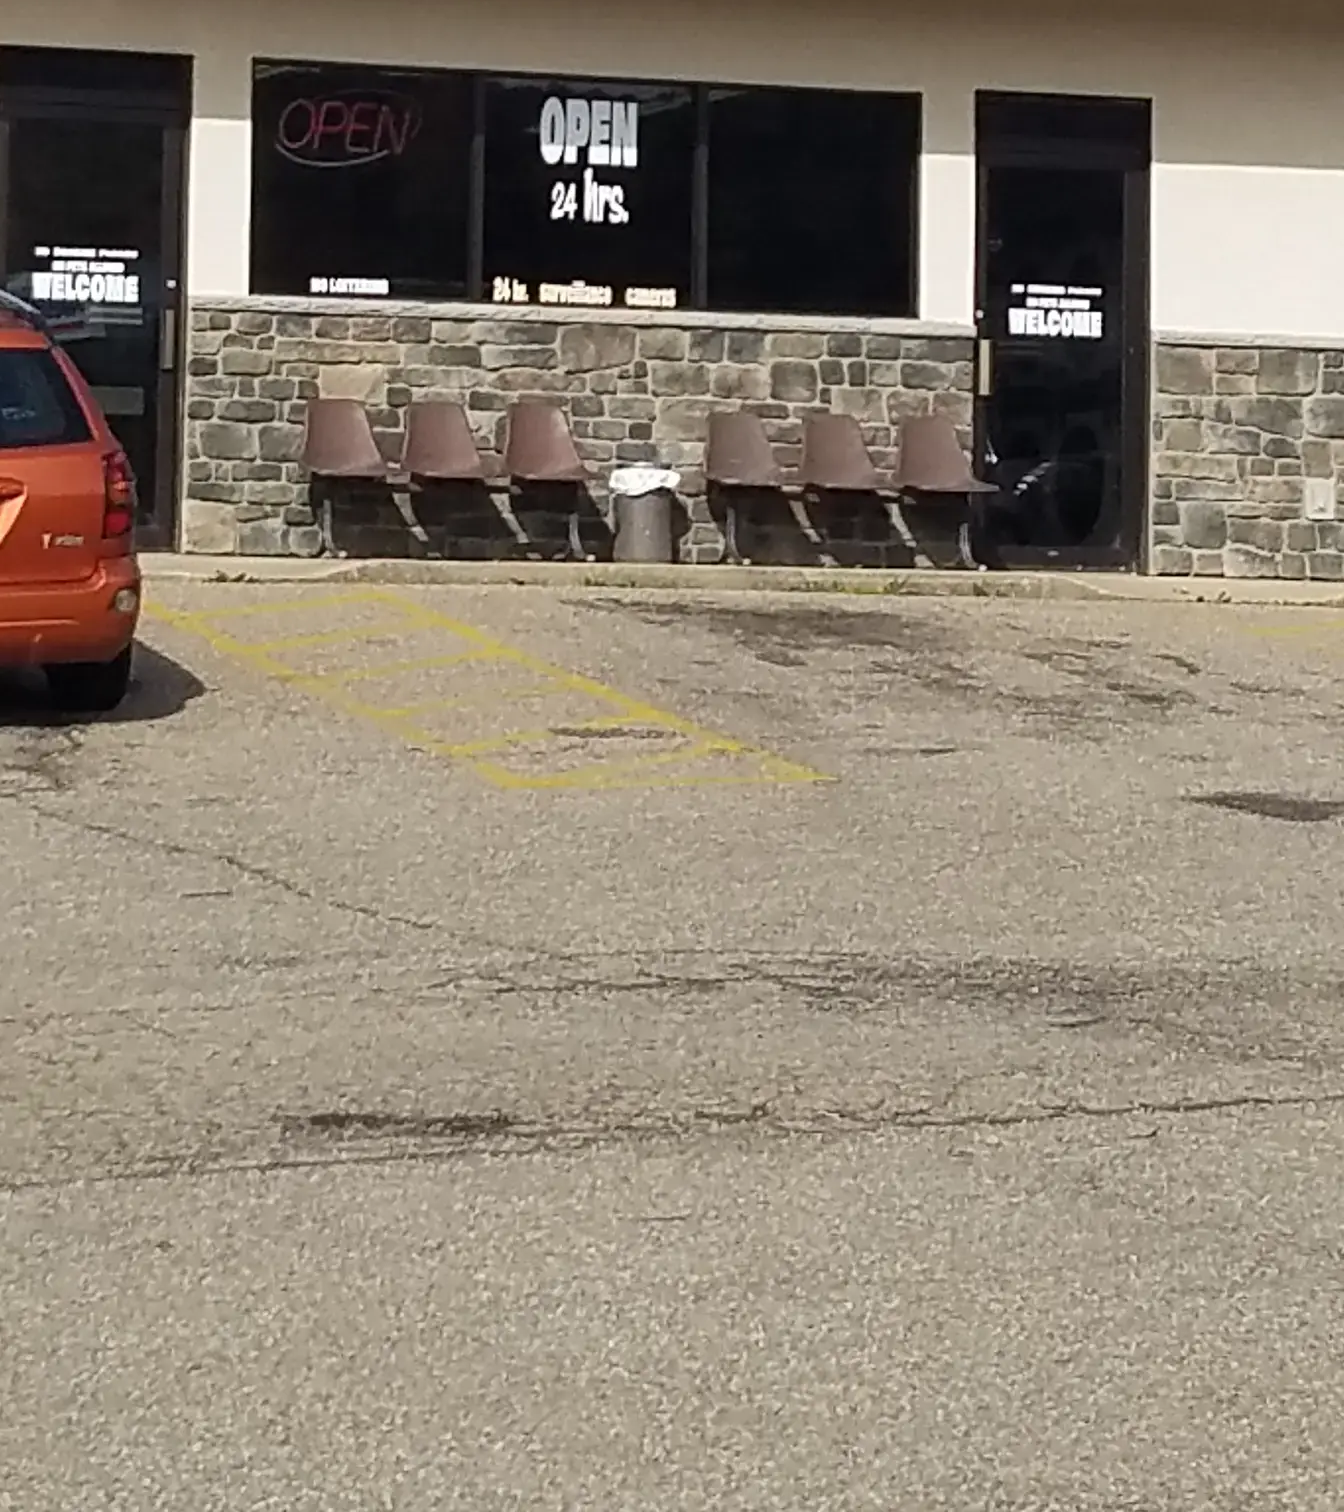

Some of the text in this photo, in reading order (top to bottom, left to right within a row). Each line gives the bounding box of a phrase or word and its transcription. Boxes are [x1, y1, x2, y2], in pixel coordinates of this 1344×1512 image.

[278, 97, 410, 155] OPEN
[539, 95, 639, 168] OPEN
[549, 166, 630, 225] 24 hrs.
[31, 271, 140, 303] WELCOME
[1007, 306, 1103, 340] WELCOME
